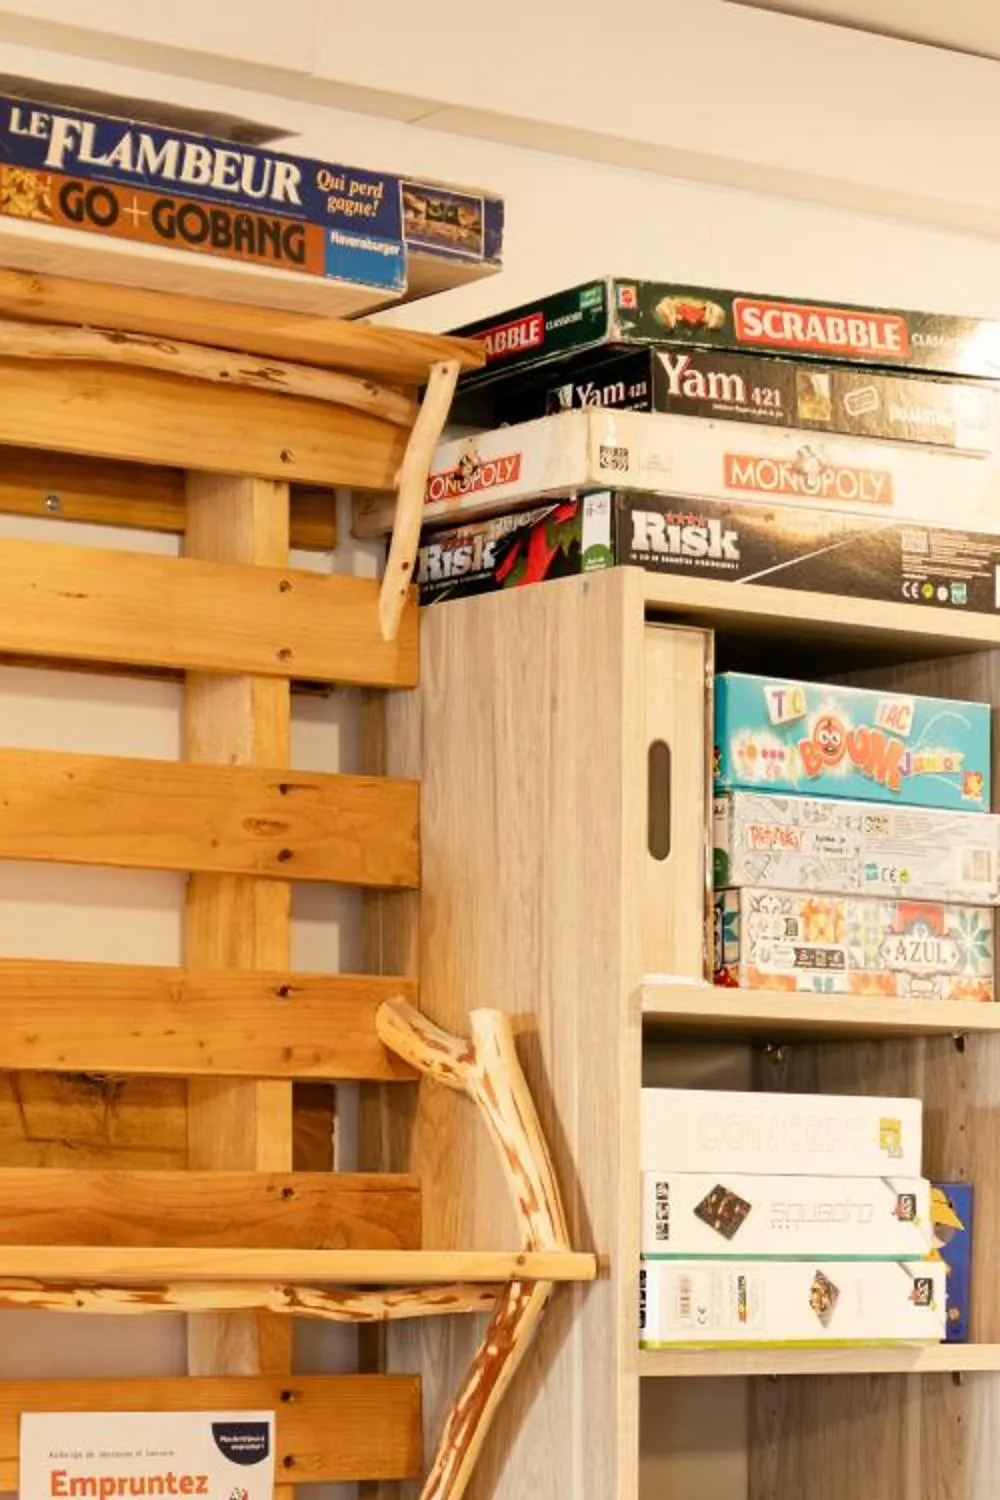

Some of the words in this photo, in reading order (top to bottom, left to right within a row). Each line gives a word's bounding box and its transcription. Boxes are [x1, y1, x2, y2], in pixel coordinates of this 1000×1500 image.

[8, 107, 49, 139] LE
[44, 114, 303, 206] FLAMBEUR
[316, 169, 345, 193] Qui
[349, 180, 384, 199] perd
[58, 181, 119, 227] GO
[152, 198, 306, 265] GOBANG
[327, 195, 379, 218] gagne!
[483, 319, 540, 353] ABBLE
[741, 307, 902, 351] SCRABBLE
[576, 381, 625, 407] Yam
[657, 352, 745, 402] Yam
[751, 387, 781, 407] 421
[426, 457, 518, 500] ONOPOLY
[731, 459, 886, 501] MONOPOLY
[631, 510, 741, 560] Risk
[895, 941, 948, 964] AZUL
